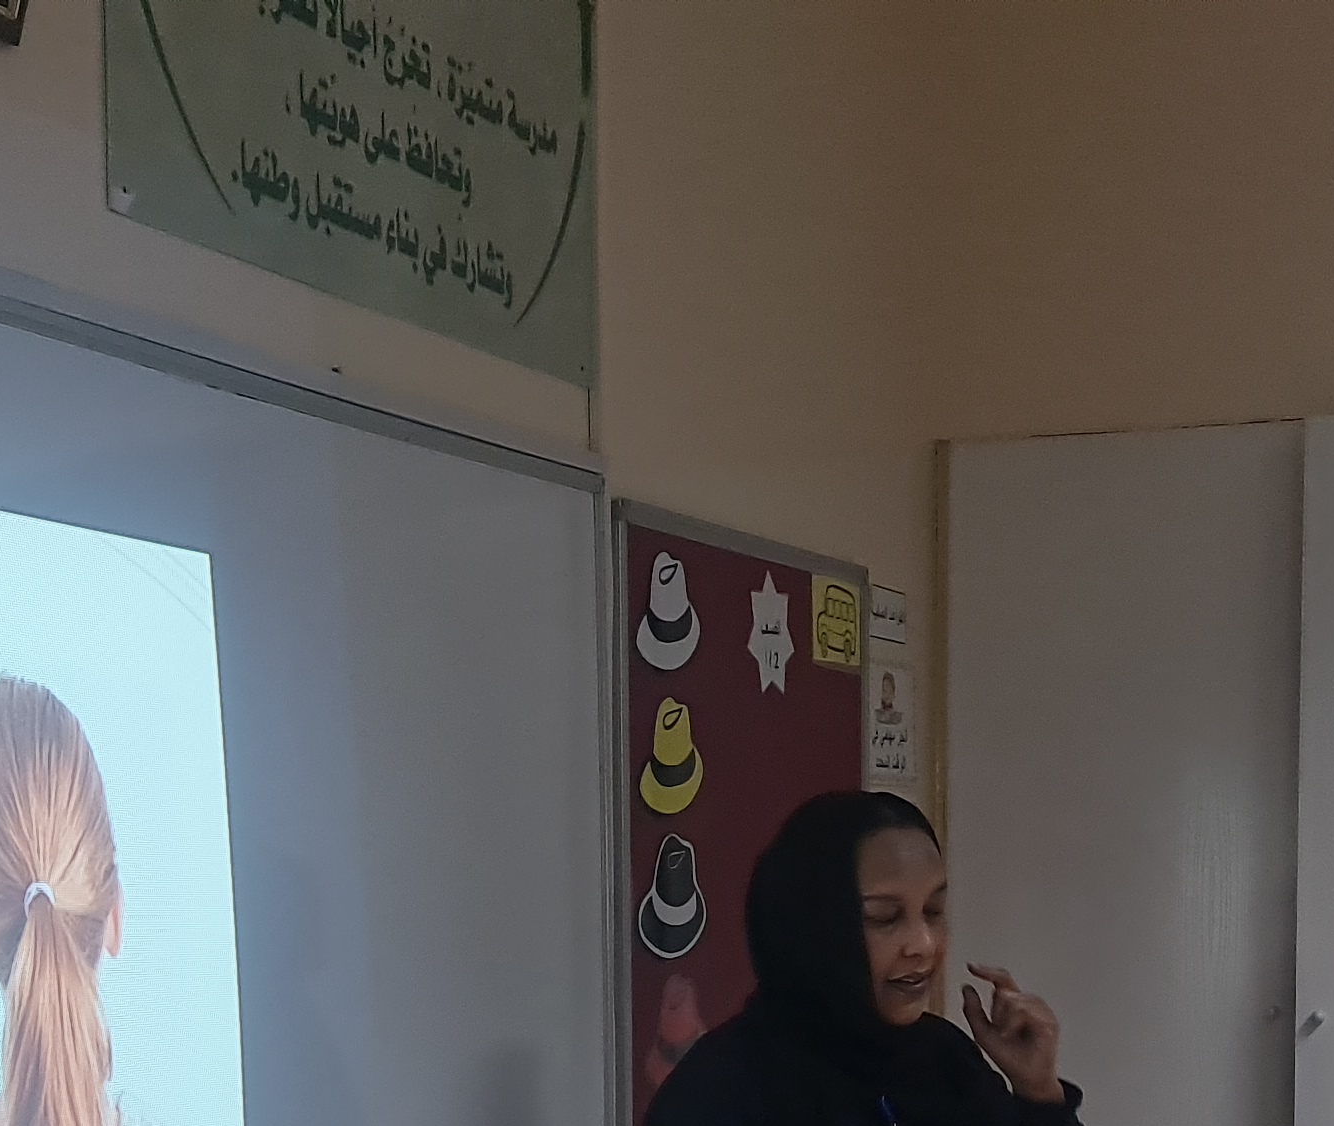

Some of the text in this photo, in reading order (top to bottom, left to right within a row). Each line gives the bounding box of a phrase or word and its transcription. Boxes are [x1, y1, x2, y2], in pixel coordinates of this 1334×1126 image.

[363, 110, 402, 165] على
[507, 89, 558, 156] مدرسة
[404, 118, 473, 208] وتحافظ
[306, 171, 383, 240] مستقبل
[386, 207, 419, 274] بناء
[423, 224, 448, 286] في
[450, 230, 513, 309] وتشارك
